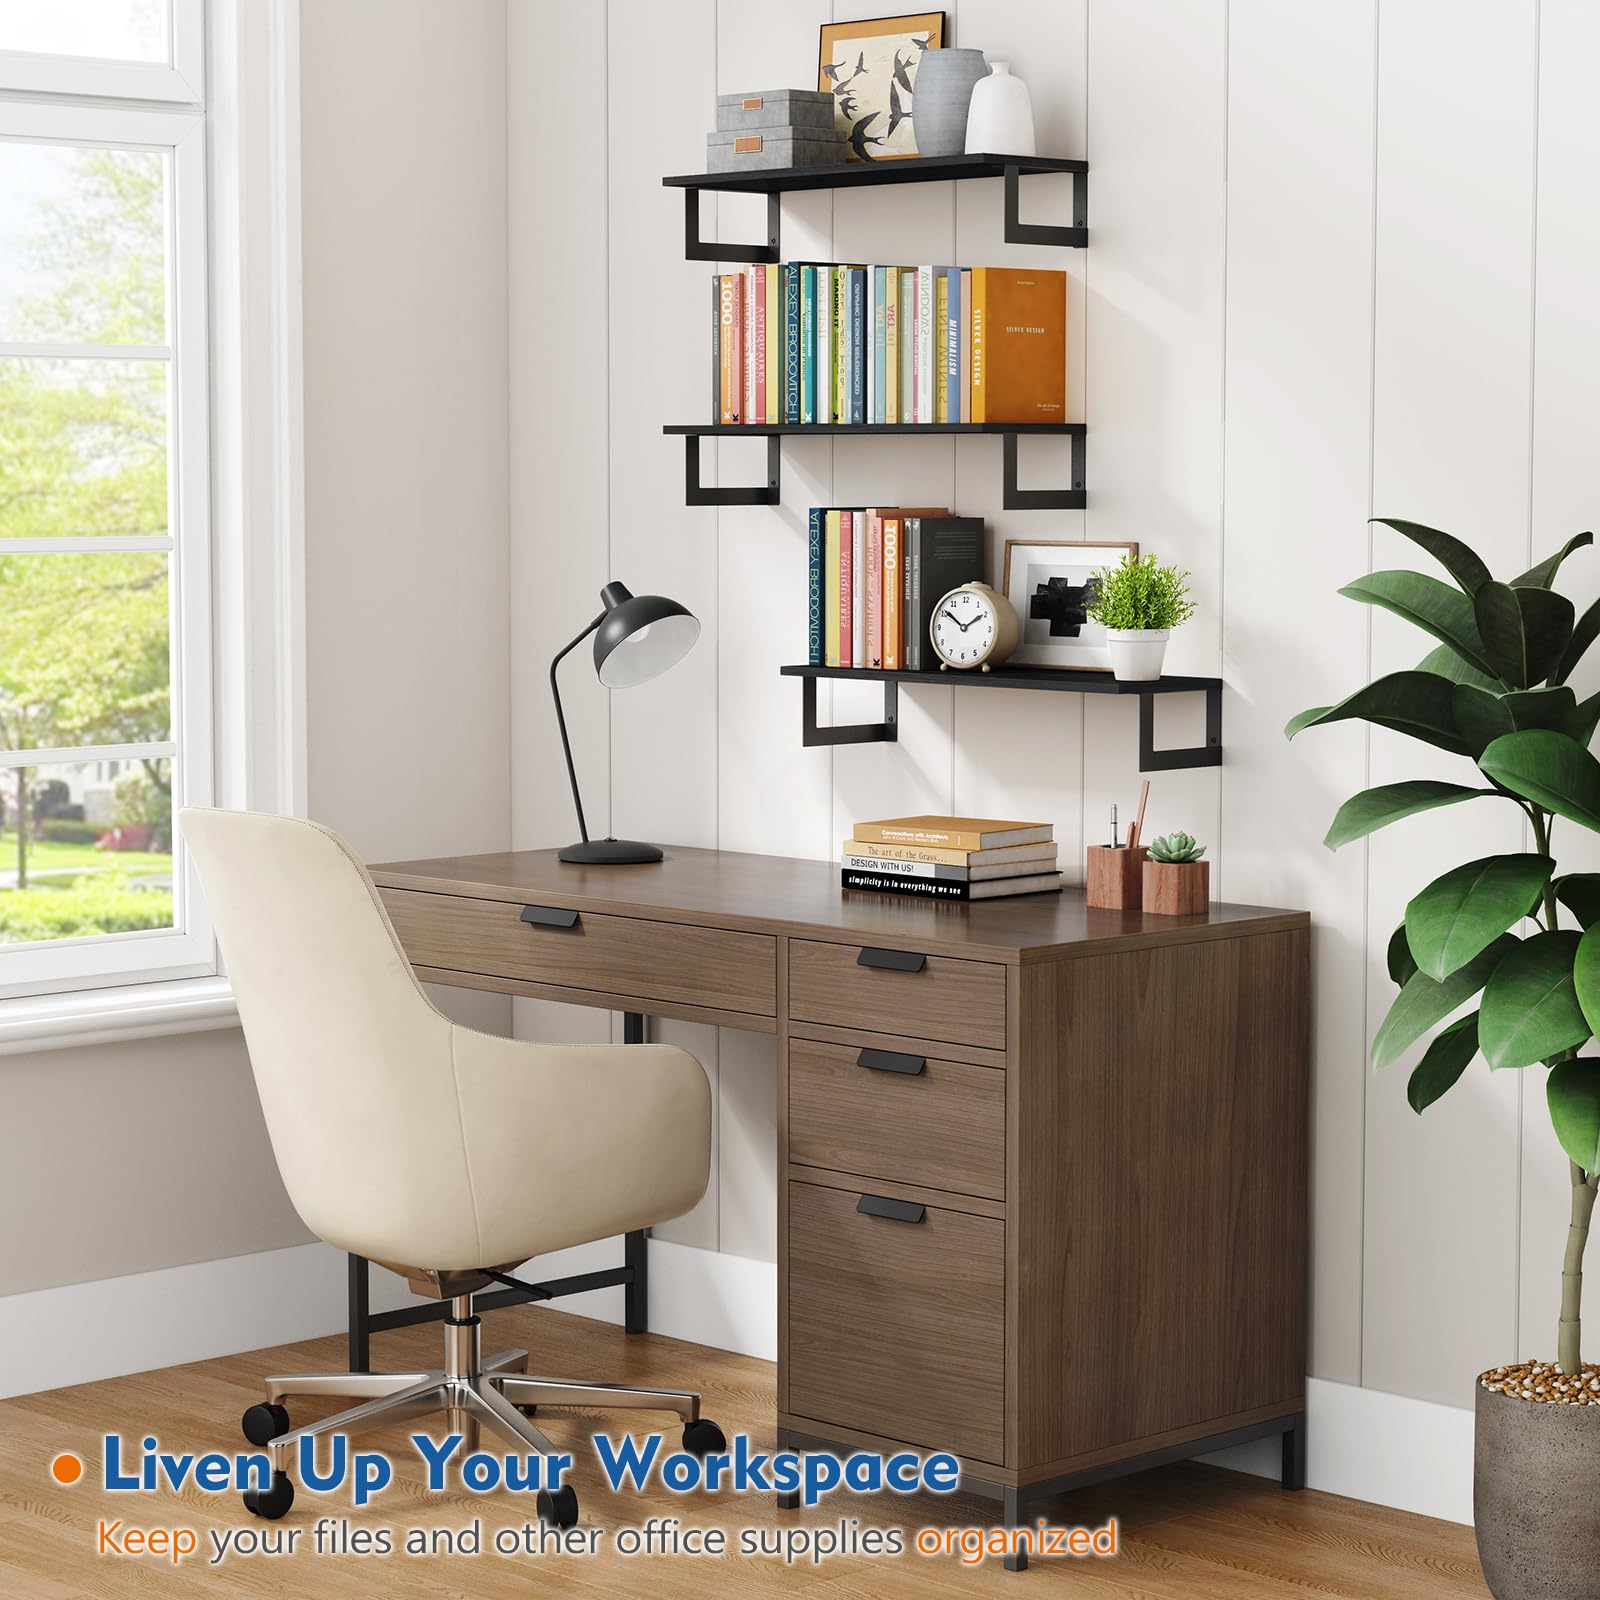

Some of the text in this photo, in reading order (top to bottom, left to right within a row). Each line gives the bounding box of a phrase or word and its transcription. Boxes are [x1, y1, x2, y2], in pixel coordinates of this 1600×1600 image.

[722, 280, 732, 325] 1000
[833, 318, 839, 329] IT
[788, 265, 798, 414] ALEXEY BRODOVITCH
[949, 319, 957, 376] MINIMALISM
[963, 596, 970, 604] 12
[940, 638, 945, 646] 8
[868, 846, 879, 855] The
[881, 847, 892, 856] art
[894, 849, 902, 858] of
[906, 850, 916, 859] the
[851, 858, 914, 873] DESIGN WITH US!
[848, 875, 882, 887] simplicity
[883, 878, 890, 886] is
[891, 879, 898, 888] in
[900, 881, 936, 894] everything
[949, 887, 961, 895] see
